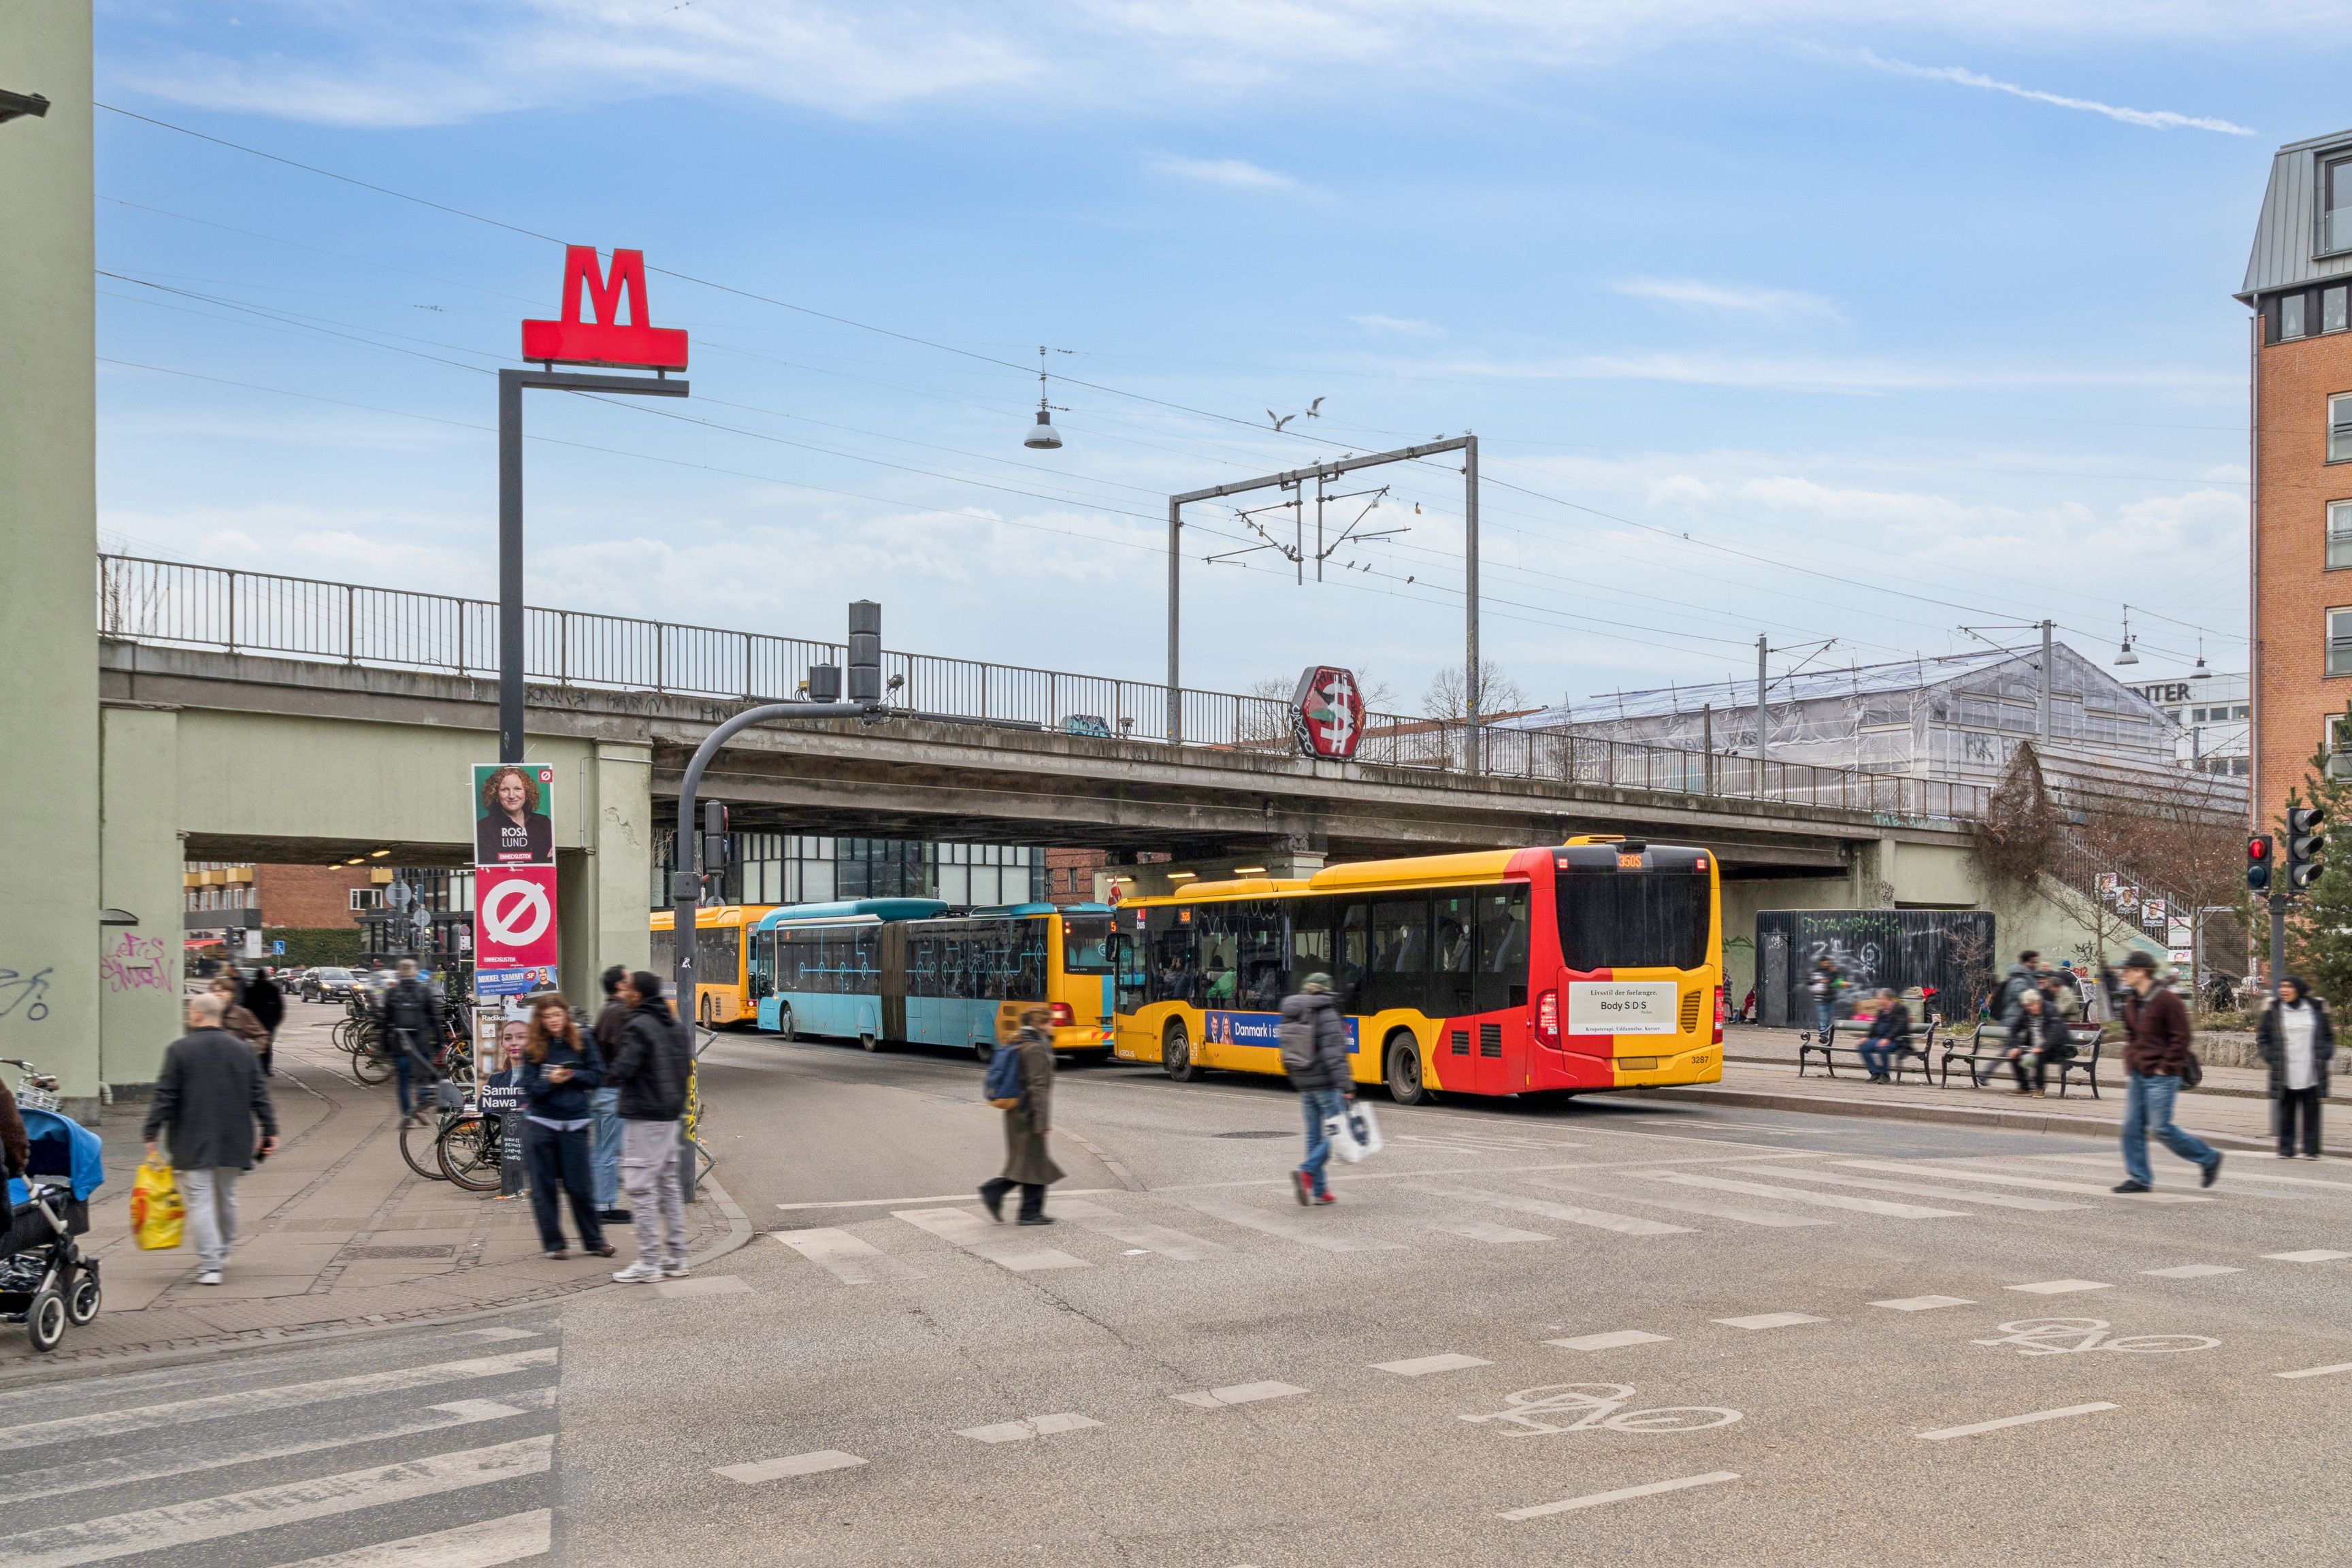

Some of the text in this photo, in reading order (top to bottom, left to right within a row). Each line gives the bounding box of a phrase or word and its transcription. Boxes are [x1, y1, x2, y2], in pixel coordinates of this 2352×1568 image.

[561, 244, 650, 327] M
[2133, 683, 2191, 702] NTER
[502, 828, 527, 836] ROSA
[502, 838, 528, 847] LUND
[1618, 855, 1642, 868] 350S
[1137, 921, 1145, 930] bus
[478, 973, 524, 983] MIKKEL SAMMY
[1601, 1001, 1623, 1011] Body
[1235, 1022, 1268, 1038] Danmark
[1691, 1056, 1709, 1064] 3287
[482, 1096, 517, 1108] Nawa
